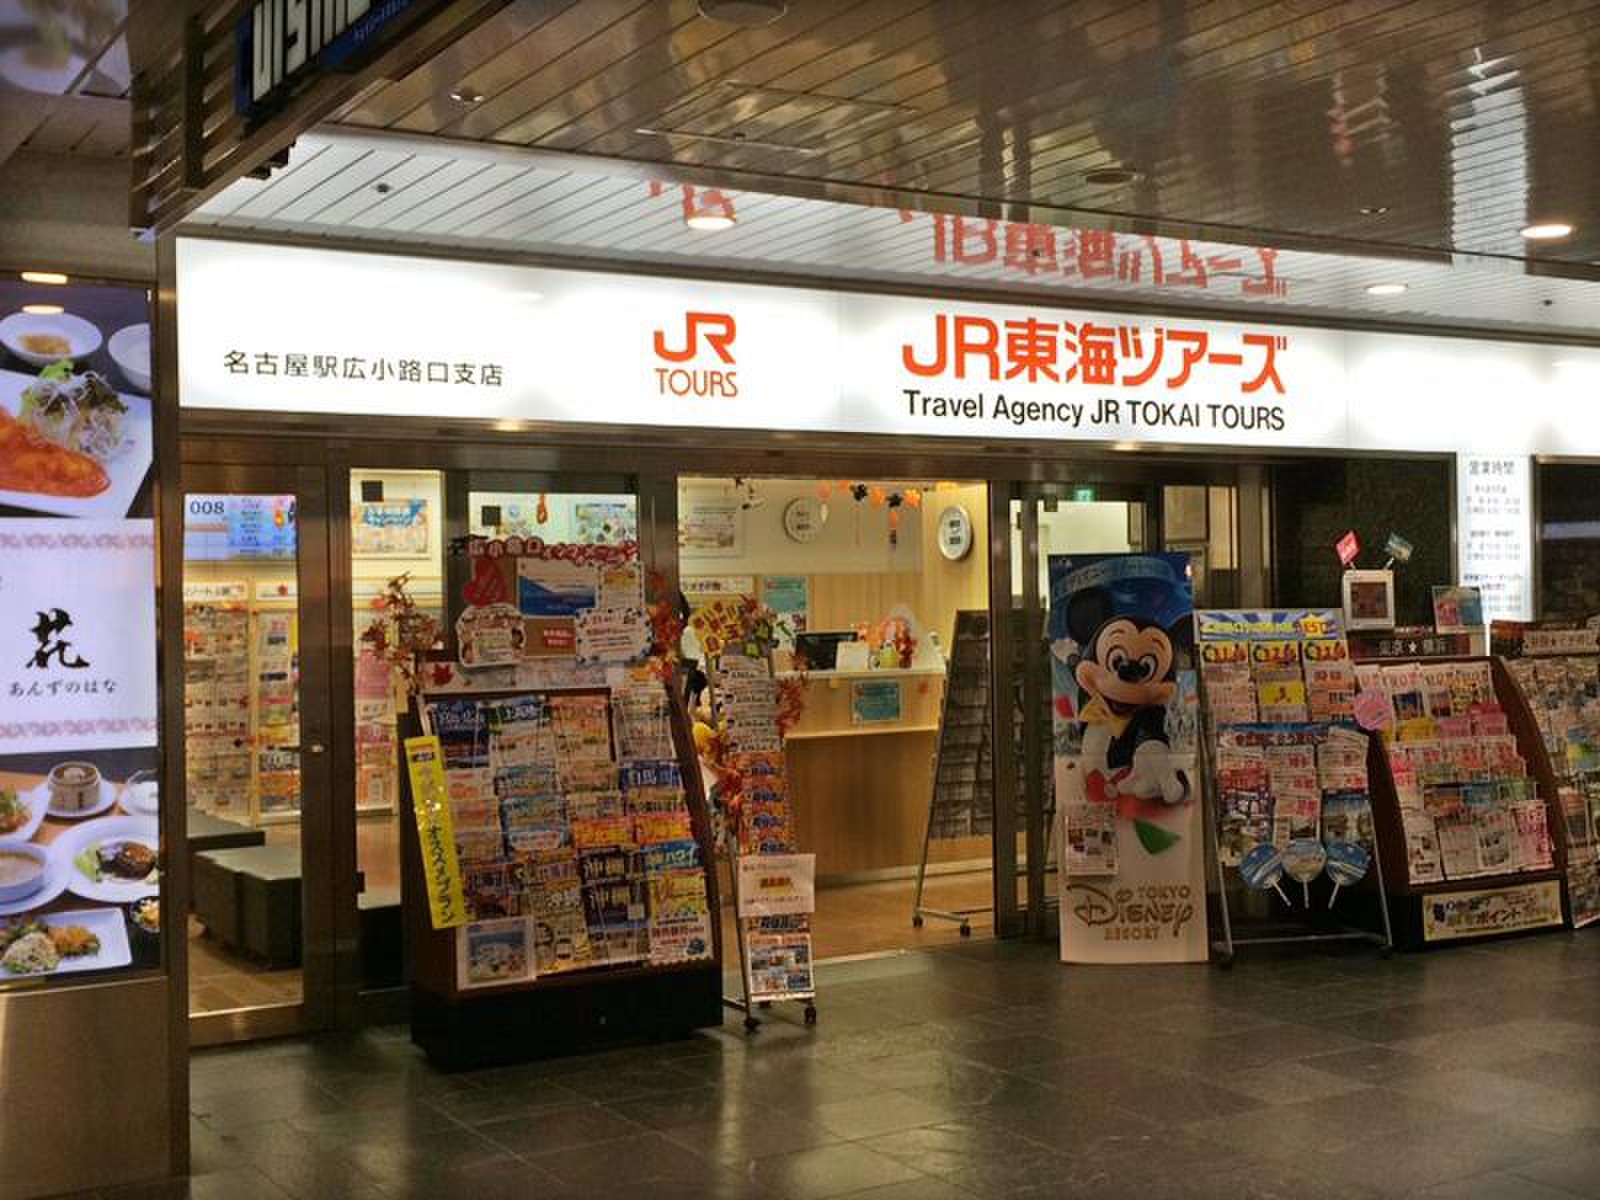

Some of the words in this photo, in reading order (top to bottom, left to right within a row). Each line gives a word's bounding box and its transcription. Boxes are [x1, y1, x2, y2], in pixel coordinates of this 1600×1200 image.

[653, 311, 737, 365] JR
[902, 314, 1287, 395] JR東海ツアーズ
[223, 349, 504, 387] 名古屋駅広小路口支店
[653, 367, 739, 397] TOURS
[903, 389, 984, 418] Travel
[991, 394, 1083, 428] Agency
[1090, 399, 1120, 425] JR
[1129, 400, 1200, 427] TOKAI
[1210, 404, 1286, 431] TOURS
[190, 500, 225, 514] 008
[25, 607, 90, 669] 花
[9, 680, 116, 697] あんずのはな
